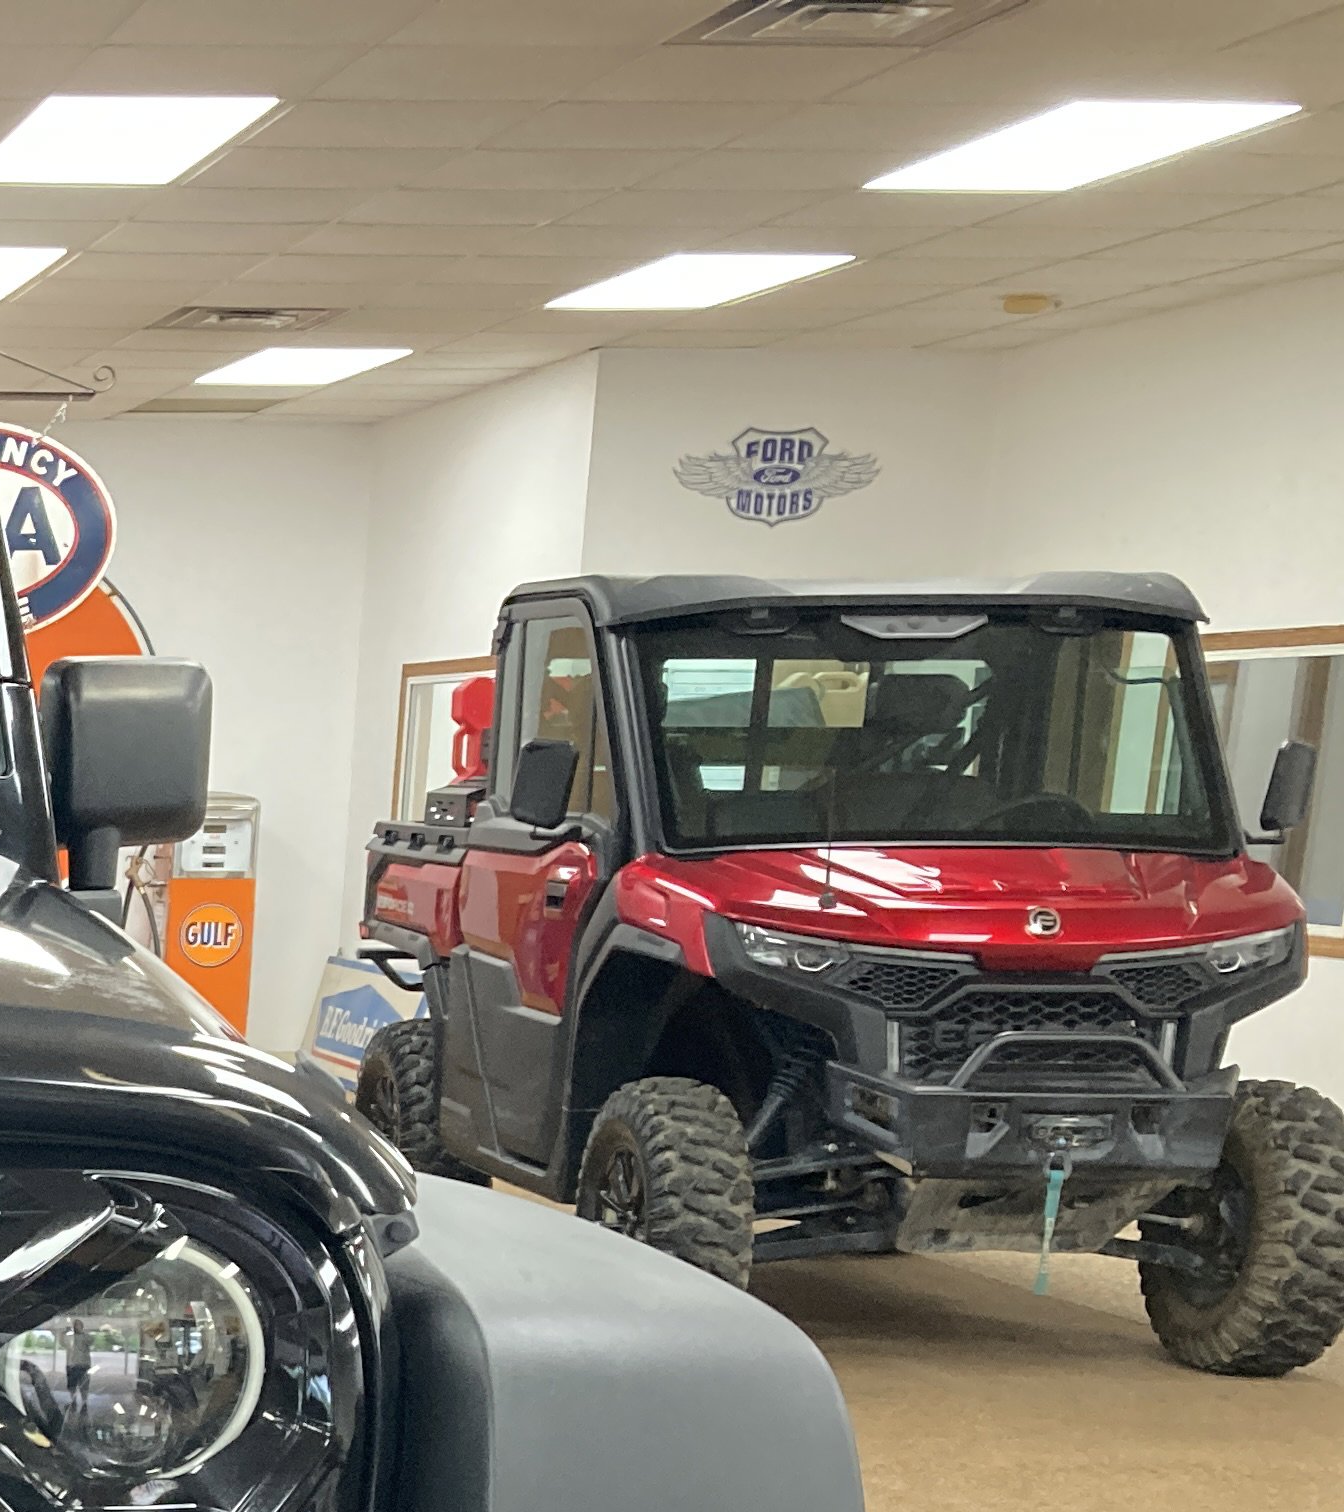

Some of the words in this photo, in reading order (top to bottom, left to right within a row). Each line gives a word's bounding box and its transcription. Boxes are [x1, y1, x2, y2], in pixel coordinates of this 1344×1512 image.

[745, 437, 814, 465] FORD
[759, 467, 793, 483] Ford
[735, 487, 814, 517] MOTORS
[185, 920, 237, 948] GULF
